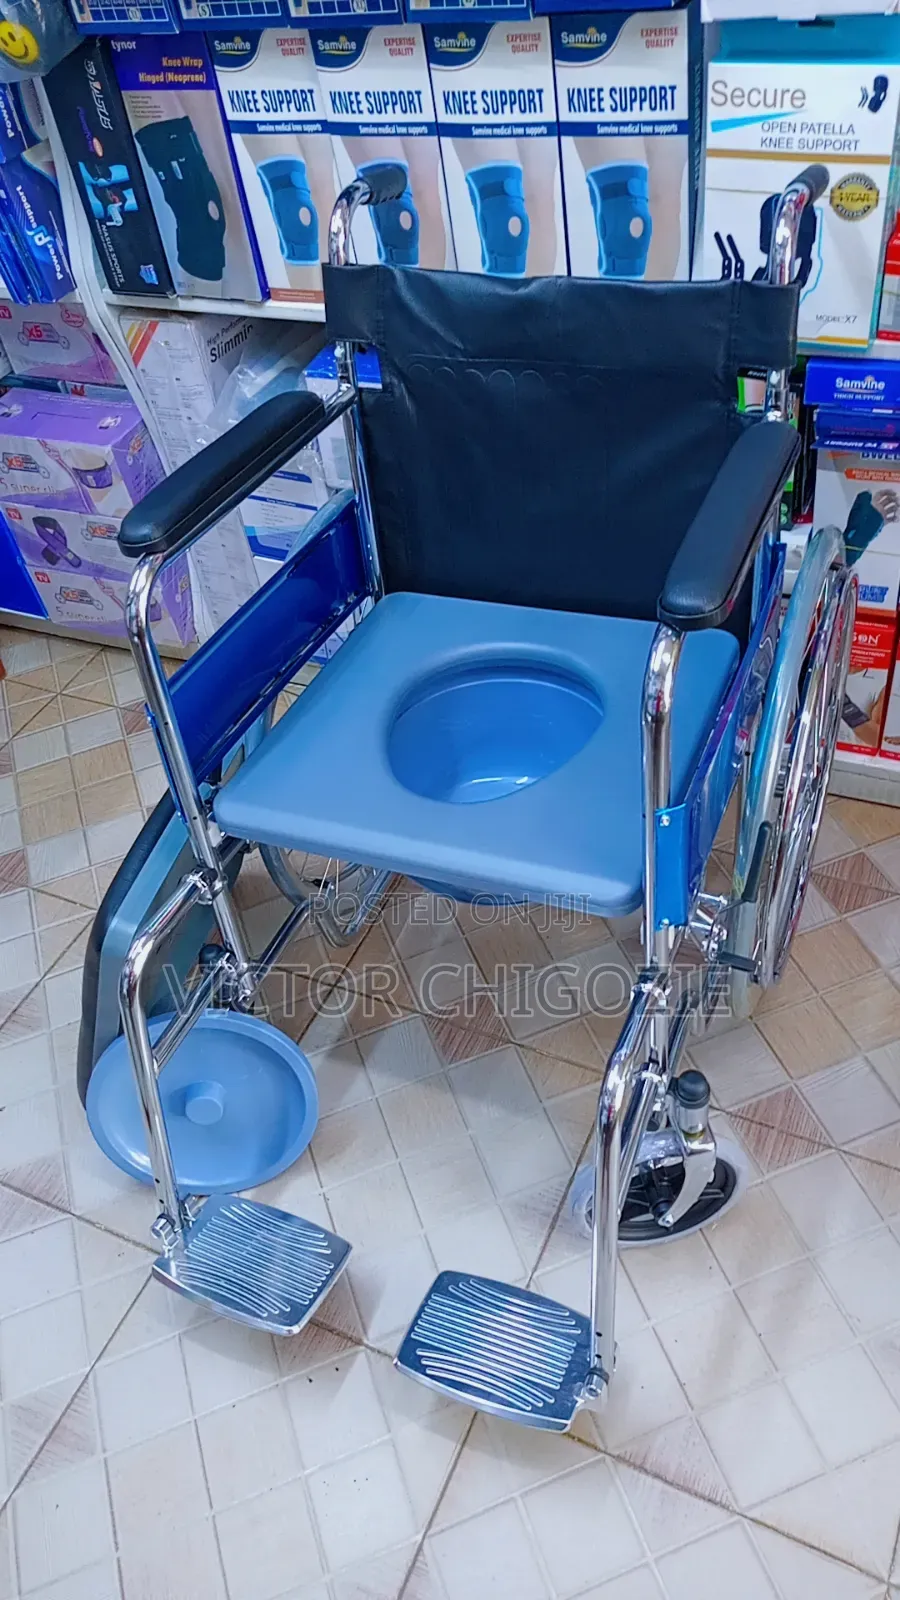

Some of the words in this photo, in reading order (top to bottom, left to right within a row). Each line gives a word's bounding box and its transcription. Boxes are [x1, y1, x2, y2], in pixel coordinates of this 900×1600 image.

[561, 31, 607, 44] Samvine
[640, 26, 679, 37] EXPERTISE
[276, 37, 306, 47] EXPERTISE
[383, 37, 416, 47] EXPERTISE
[434, 36, 476, 48] Samvine
[506, 33, 542, 43] EXPERTISE
[645, 38, 675, 49] QUALITY
[111, 40, 136, 52] tynor
[214, 40, 251, 51] Samvine
[317, 39, 357, 51] Samvine
[511, 44, 538, 54] QUALITY
[281, 47, 305, 56] QUALITY
[389, 47, 414, 57] QUALITY
[162, 57, 180, 67] Knee
[182, 57, 203, 68] Wrap
[139, 72, 164, 84] Hinged
[165, 73, 206, 84] (Neoprene)
[567, 87, 605, 113] KNEE
[609, 85, 677, 112] SUPPORT
[710, 80, 806, 109] Secure
[227, 90, 260, 113] KNEE
[261, 89, 316, 113] SUPPORT
[329, 90, 363, 114] KNEE
[365, 90, 423, 115] SUPPORT
[442, 90, 478, 115] KNEE
[481, 89, 544, 114] SUPPORT
[358, 124, 378, 134] Samvine
[378, 125, 395, 134] medical
[396, 125, 407, 134] knee
[407, 126, 428, 136] supports
[472, 126, 492, 136] Samvine
[492, 126, 512, 135] medical
[512, 126, 525, 135] knee
[525, 126, 547, 136] supports
[597, 124, 619, 134] Samvine
[619, 123, 640, 134] medical
[640, 123, 654, 133] knee
[654, 123, 678, 135] supports
[761, 121, 797, 134] OPEN
[800, 122, 855, 136] PATELLA
[760, 136, 794, 149] KNEE
[798, 138, 860, 152] SUPPORT
[15, 184, 37, 230] support
[101, 224, 114, 253] NASUS
[110, 252, 125, 283] SPORTS
[47, 241, 63, 280] Power
[835, 377, 886, 391] Samvine
